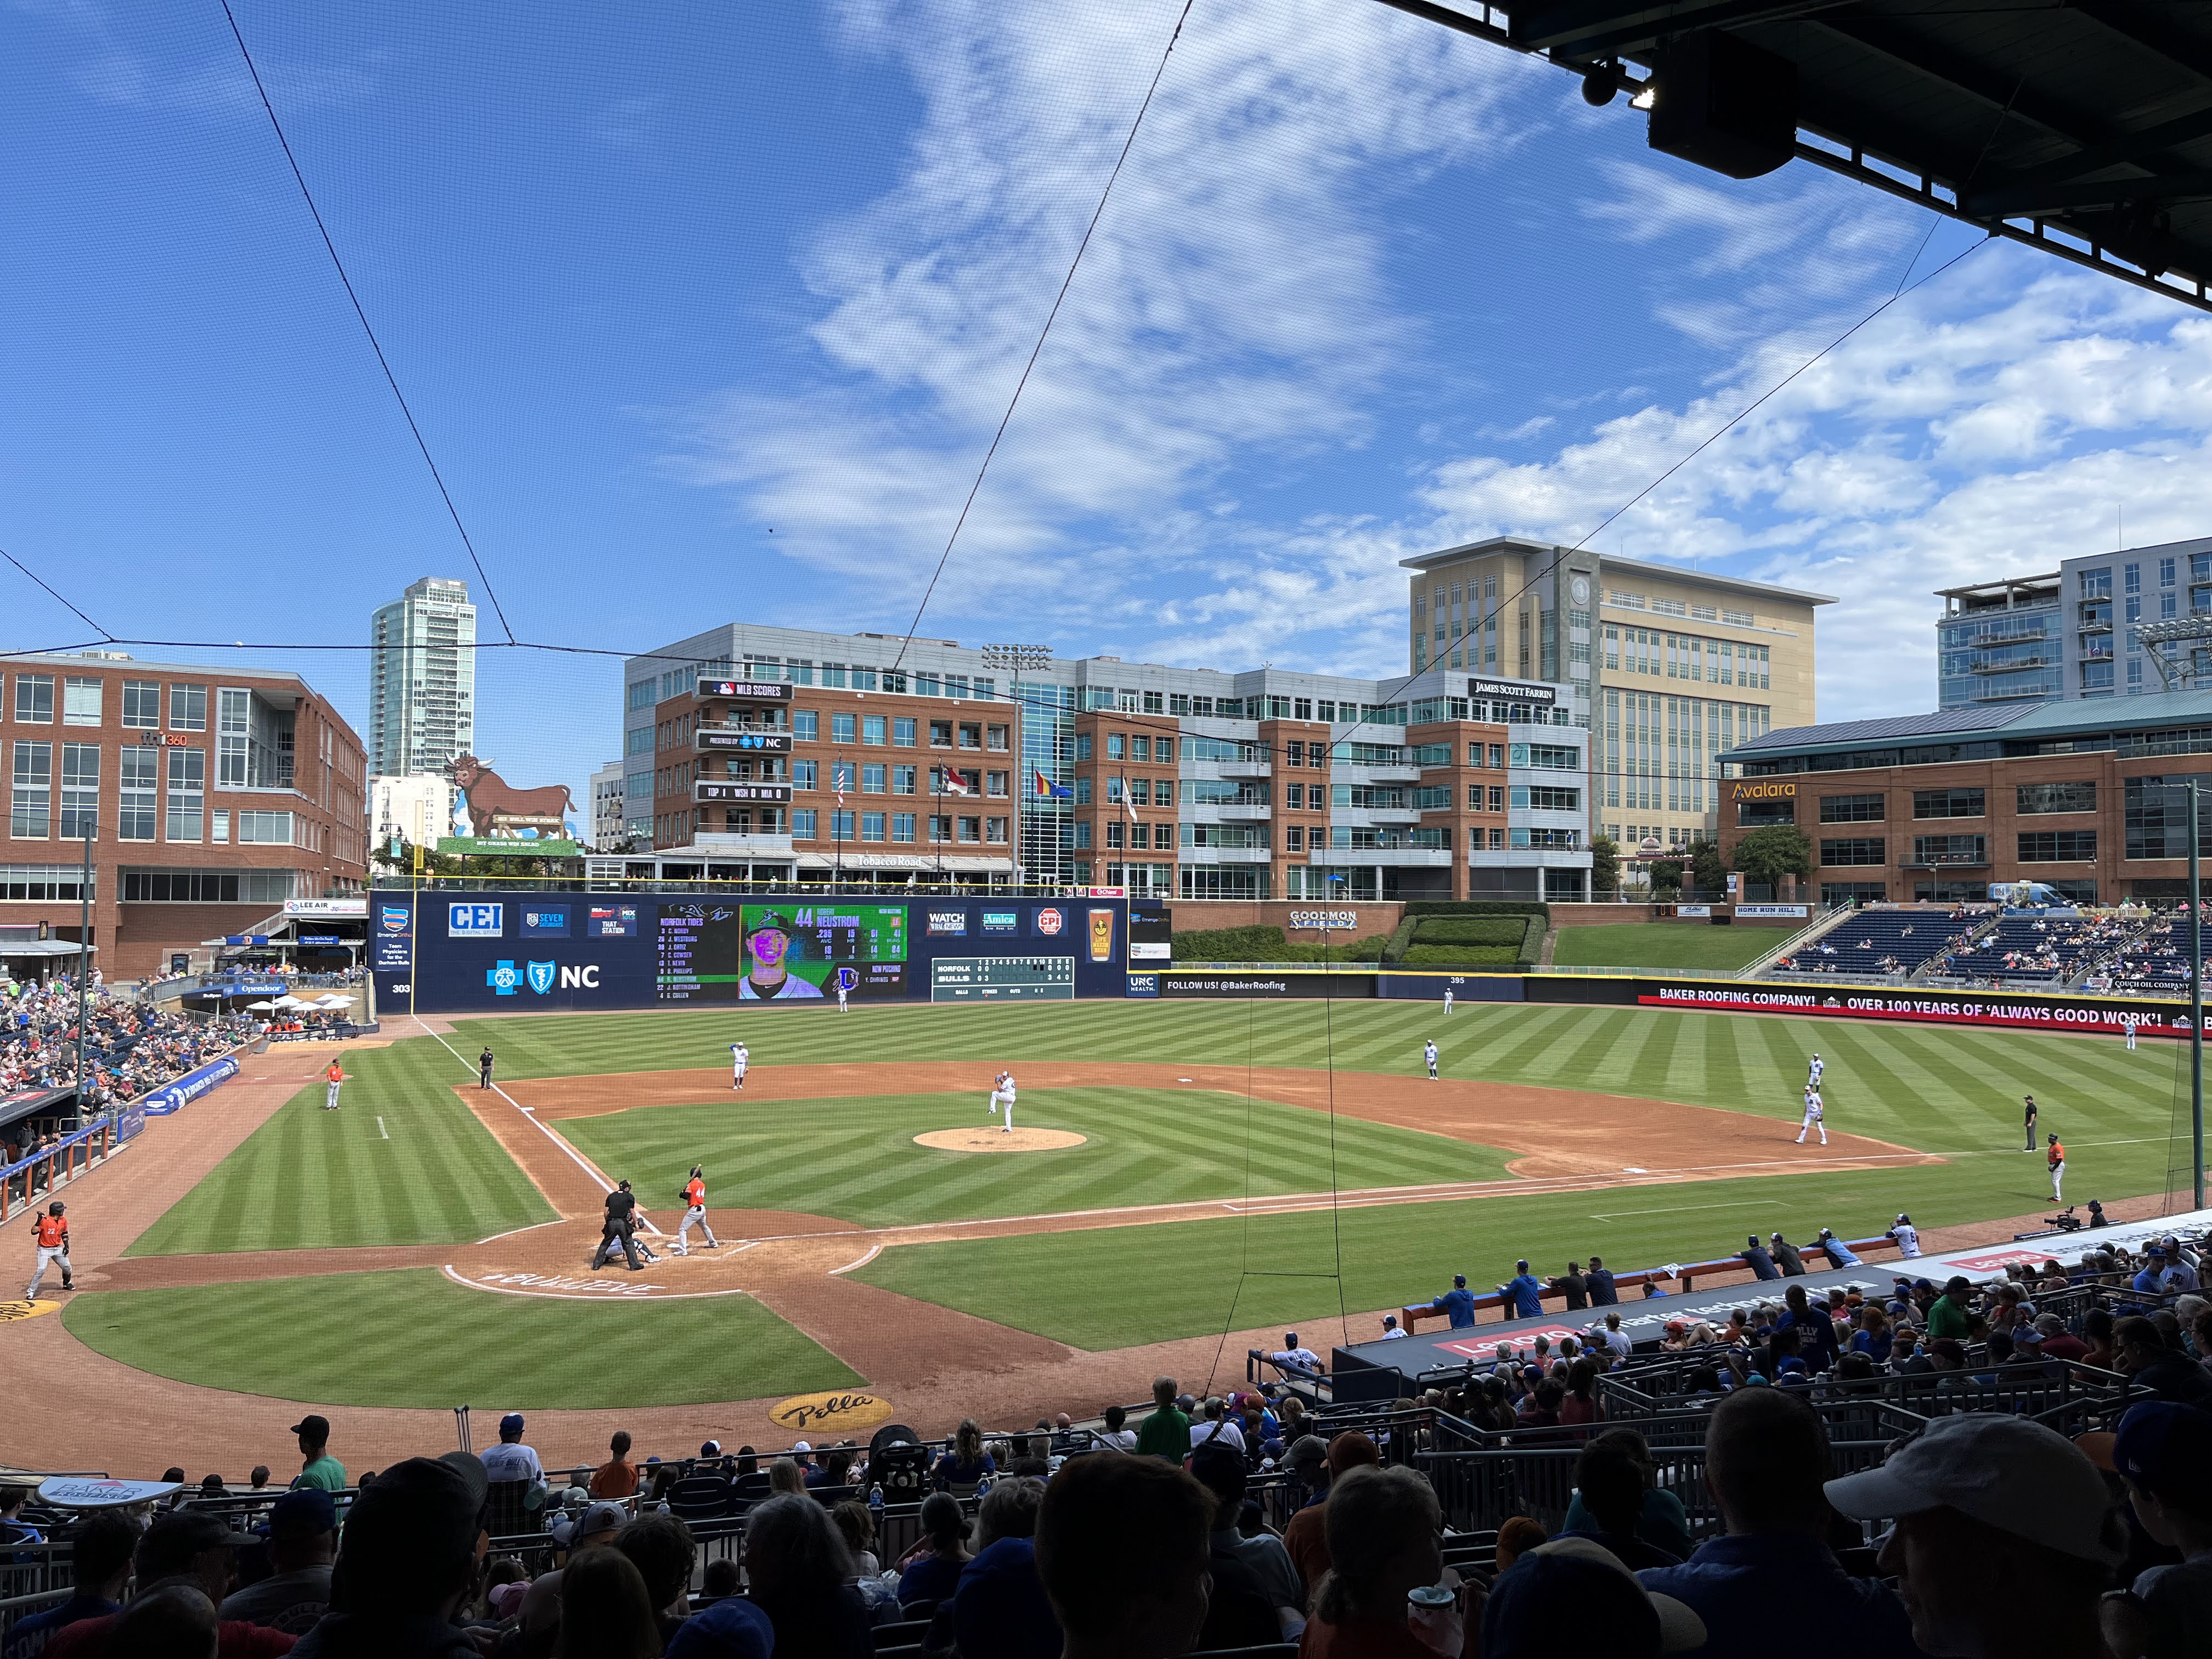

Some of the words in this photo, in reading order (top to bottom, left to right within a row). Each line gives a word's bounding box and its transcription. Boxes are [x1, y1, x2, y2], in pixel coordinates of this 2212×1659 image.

[736, 684, 751, 695] MLB
[753, 685, 781, 696] SCORES
[1475, 682, 1499, 693] JAMES
[1499, 685, 1525, 696] SCOTT
[1525, 687, 1553, 699] FARRIN
[166, 735, 187, 746] 360
[766, 738, 781, 747] NC
[708, 788, 719, 797] TOP
[761, 789, 772, 798] MIA
[1732, 782, 1796, 799] Avalara
[857, 856, 896, 866] Tobacco
[898, 856, 922, 866] Road
[450, 905, 501, 929] CEI
[539, 913, 563, 922] SEVEN
[795, 908, 813, 927] 44
[929, 913, 964, 923] WATCH
[987, 915, 1014, 924] Amica
[1290, 911, 1356, 920] GOODMON
[687, 918, 703, 926] TIDES
[817, 916, 860, 927] NEUSTROM
[561, 965, 600, 989] NC
[1130, 977, 1154, 986] UNC
[242, 985, 281, 994] Opendoor
[392, 984, 410, 993] 303
[1220, 981, 1286, 991] @BakerRoofing
[1660, 988, 1696, 1001] BAKER
[1698, 990, 1750, 1004] ROOFING
[1752, 992, 1815, 1007] COMPANY!
[1847, 997, 1883, 1011] OVER
[1886, 1000, 1911, 1013] 100
[1914, 1001, 1959, 1015] YEARS
[1962, 1003, 1982, 1016] OF
[2053, 1008, 2099, 1024] GOOD
[696, 1187, 705, 1198] 44
[1957, 1254, 2044, 1272] Lenovo
[1452, 1329, 1573, 1355] Lenovo
[1288, 1352, 1308, 1362] WILLIAMS
[781, 1395, 873, 1427] Pella
[506, 1458, 521, 1466] BULL
[57, 1483, 143, 1496] BAKER
